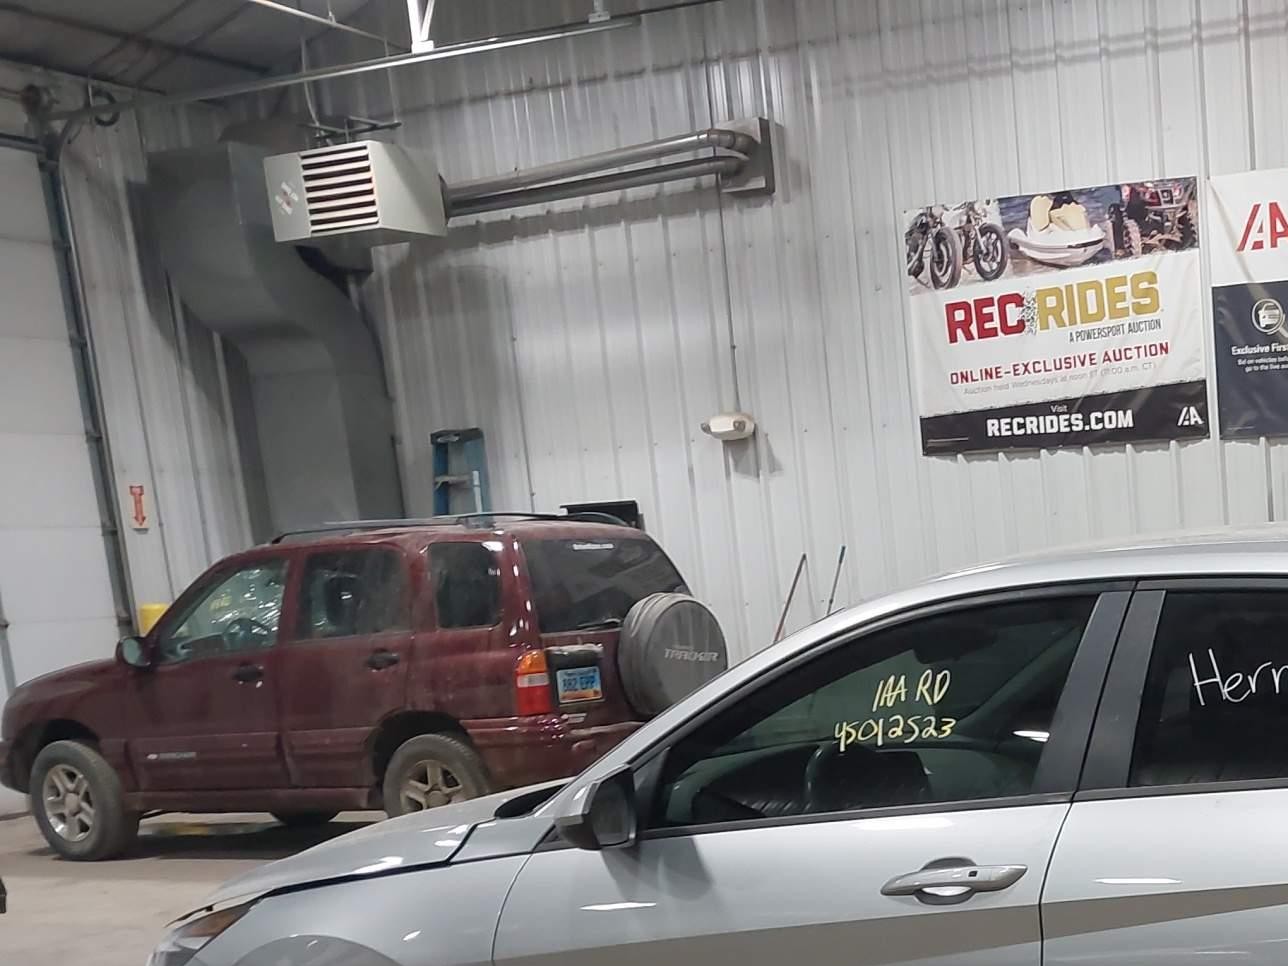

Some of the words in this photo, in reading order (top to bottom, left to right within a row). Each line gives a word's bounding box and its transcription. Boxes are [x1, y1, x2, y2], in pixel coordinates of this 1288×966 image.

[945, 292, 1026, 344] REC
[1036, 271, 1160, 331] RIDES
[1069, 332, 1074, 343] A
[1076, 324, 1125, 342] POWERSPORT
[1128, 319, 1161, 334] AUCTION
[950, 352, 1097, 385] ONLINE-EXCLUSIVE
[1102, 342, 1169, 364] AUCTION
[1232, 344, 1270, 356] Exclusive
[986, 409, 1134, 437] RECRIDES.COM
[1050, 404, 1068, 412] Visit
[872, 675, 908, 712] IAA
[834, 714, 956, 752] 45012523
